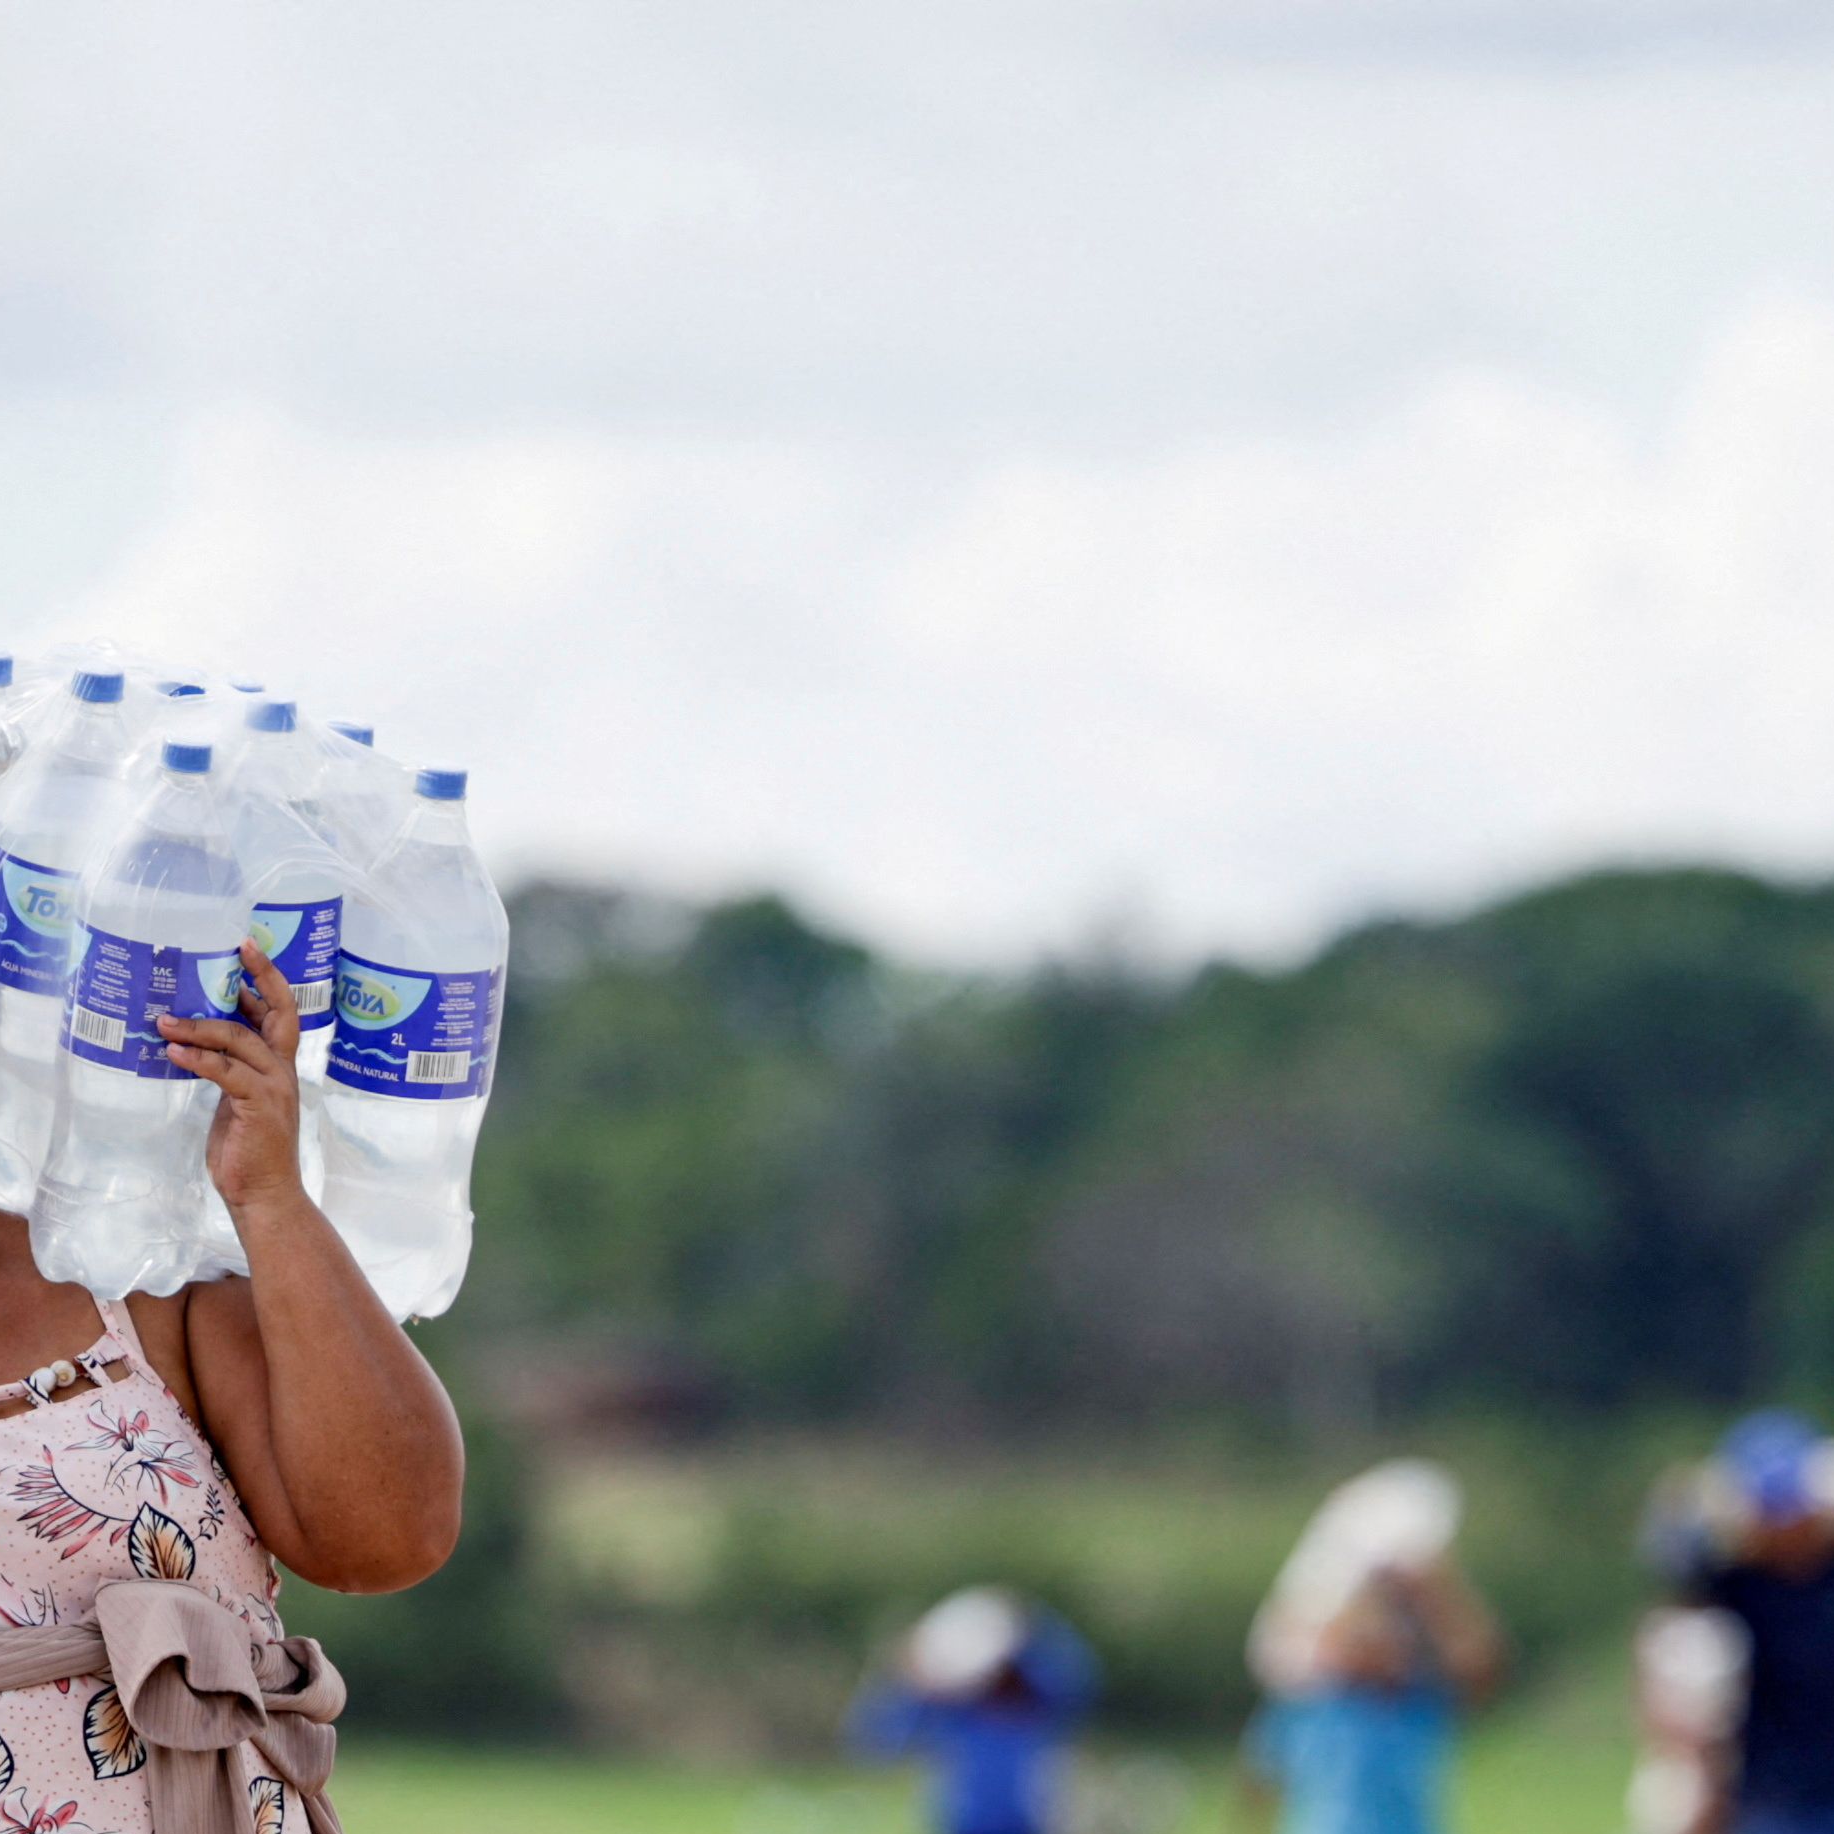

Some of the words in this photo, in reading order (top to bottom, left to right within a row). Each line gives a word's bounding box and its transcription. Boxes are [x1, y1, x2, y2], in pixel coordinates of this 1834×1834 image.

[27, 885, 71, 920] TOY
[152, 966, 174, 977] SAC
[340, 973, 387, 1018] TOYA
[391, 1033, 406, 1047] 2L
[336, 1056, 362, 1074] MINERAL
[363, 1066, 400, 1082] NATURAL
